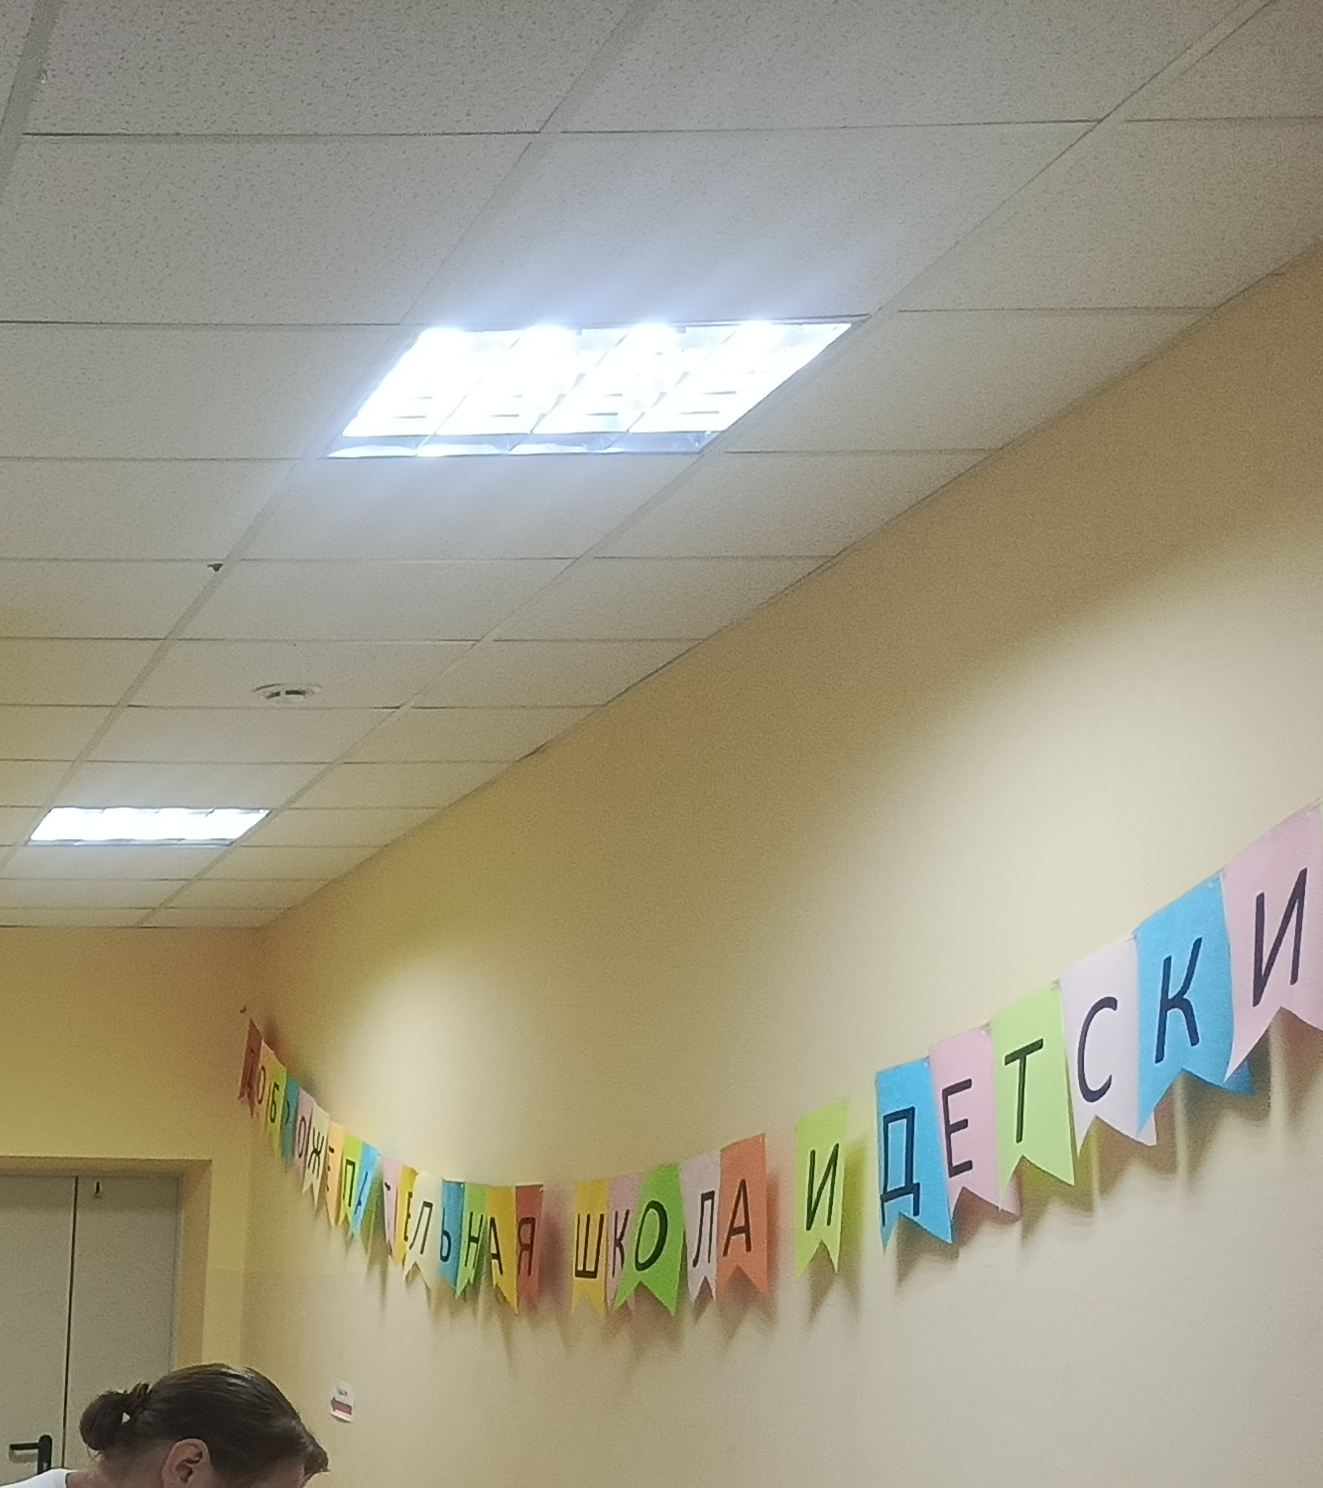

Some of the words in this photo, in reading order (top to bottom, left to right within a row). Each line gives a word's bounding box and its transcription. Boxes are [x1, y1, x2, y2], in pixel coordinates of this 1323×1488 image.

[574, 1178, 752, 1280] ШКОЛА
[806, 1147, 840, 1233] И
[879, 866, 1311, 1219] ДЕТСКИ
